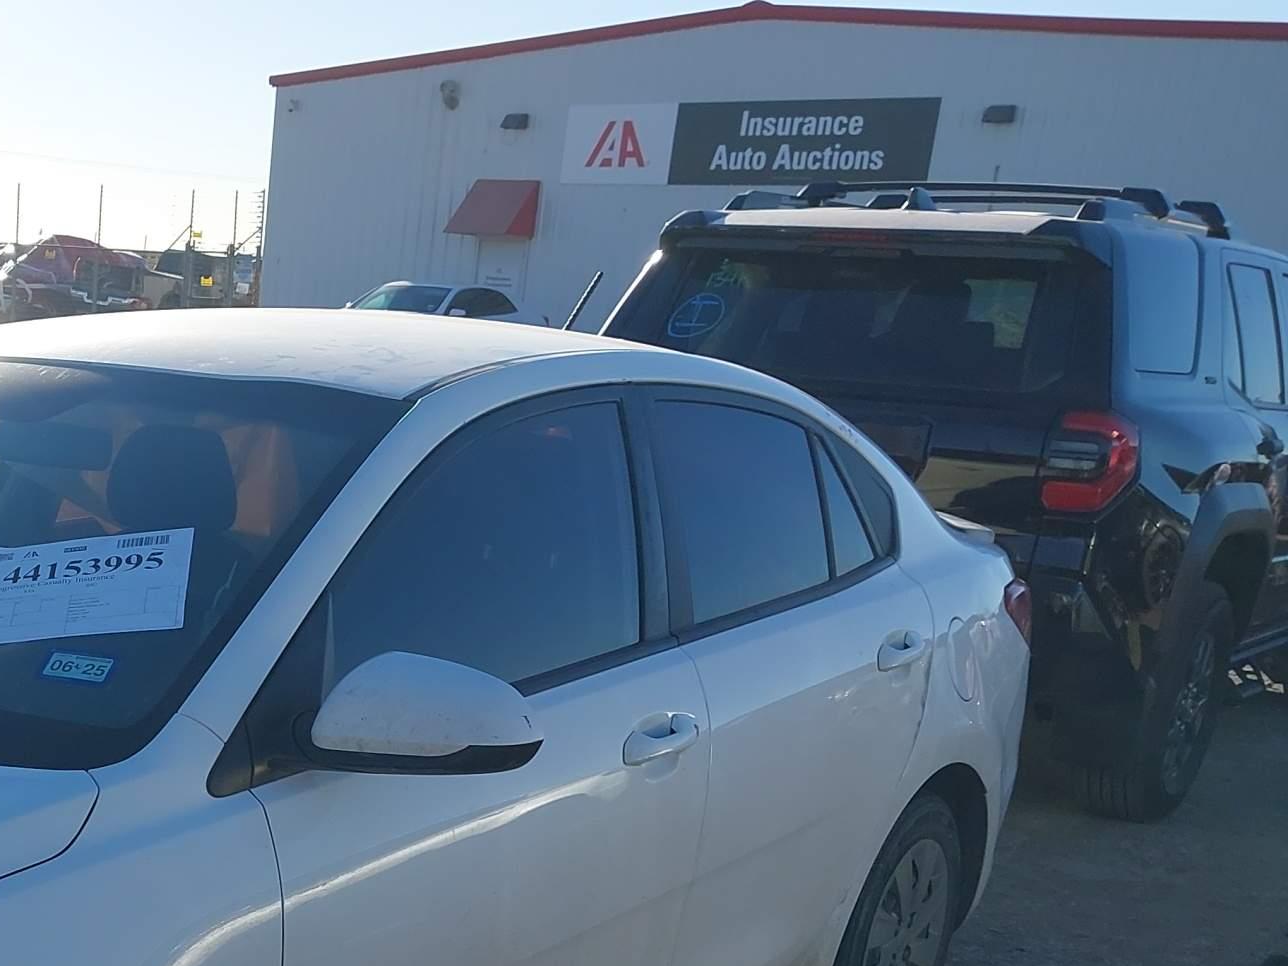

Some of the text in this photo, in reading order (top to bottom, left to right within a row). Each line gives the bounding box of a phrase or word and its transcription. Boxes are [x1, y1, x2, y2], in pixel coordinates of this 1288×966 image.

[740, 110, 864, 137] Insurance
[710, 143, 885, 171] Auto Auctions
[3, 551, 165, 584] 44153995
[75, 574, 116, 584] Insurance
[50, 659, 75, 673] 06
[81, 663, 109, 677] 25
